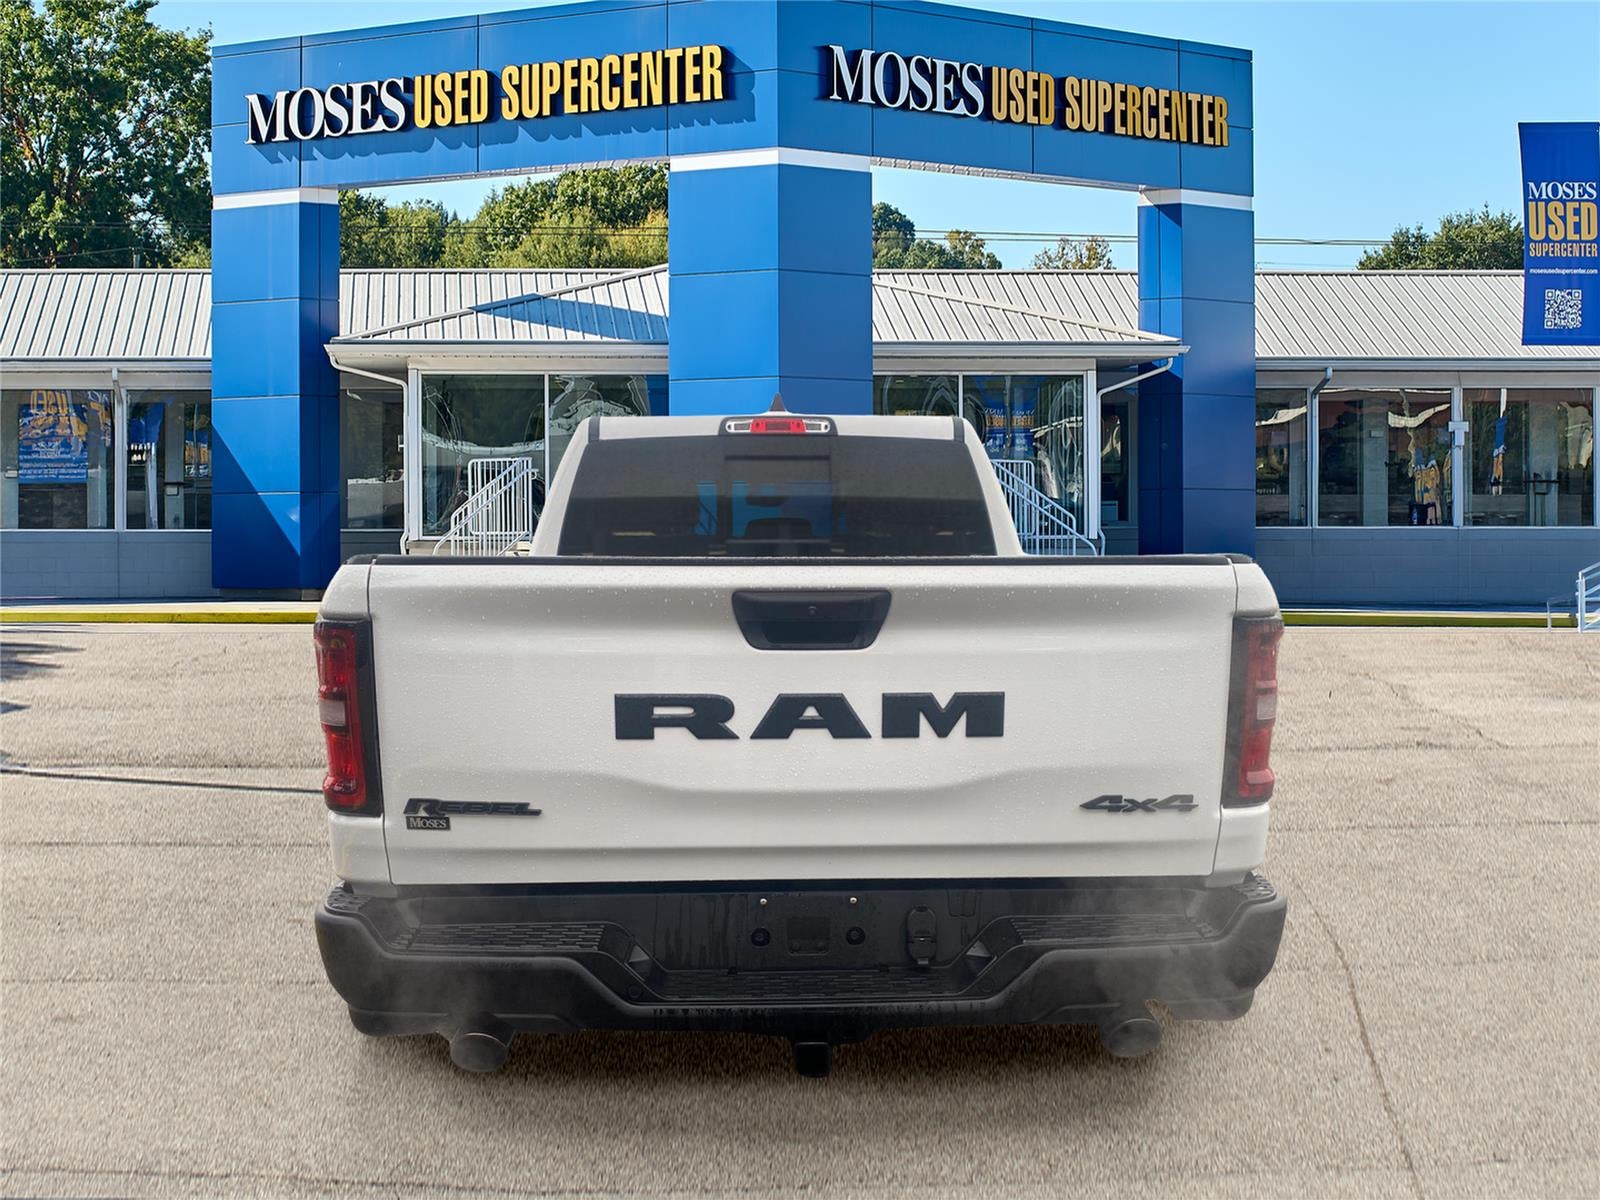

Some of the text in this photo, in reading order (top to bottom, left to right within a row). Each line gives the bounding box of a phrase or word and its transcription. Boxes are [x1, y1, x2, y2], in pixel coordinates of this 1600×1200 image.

[244, 44, 725, 145] MOSES USED SUPERCENTER
[829, 45, 1229, 147] MOSES USED SUPERCENTER
[1528, 181, 1597, 200] MOSES
[1528, 201, 1598, 241] USED
[1529, 242, 1598, 257] SUPERCENTER
[615, 691, 1006, 740] RAM
[1079, 794, 1199, 813] 4x4
[409, 817, 448, 829] MOSES
